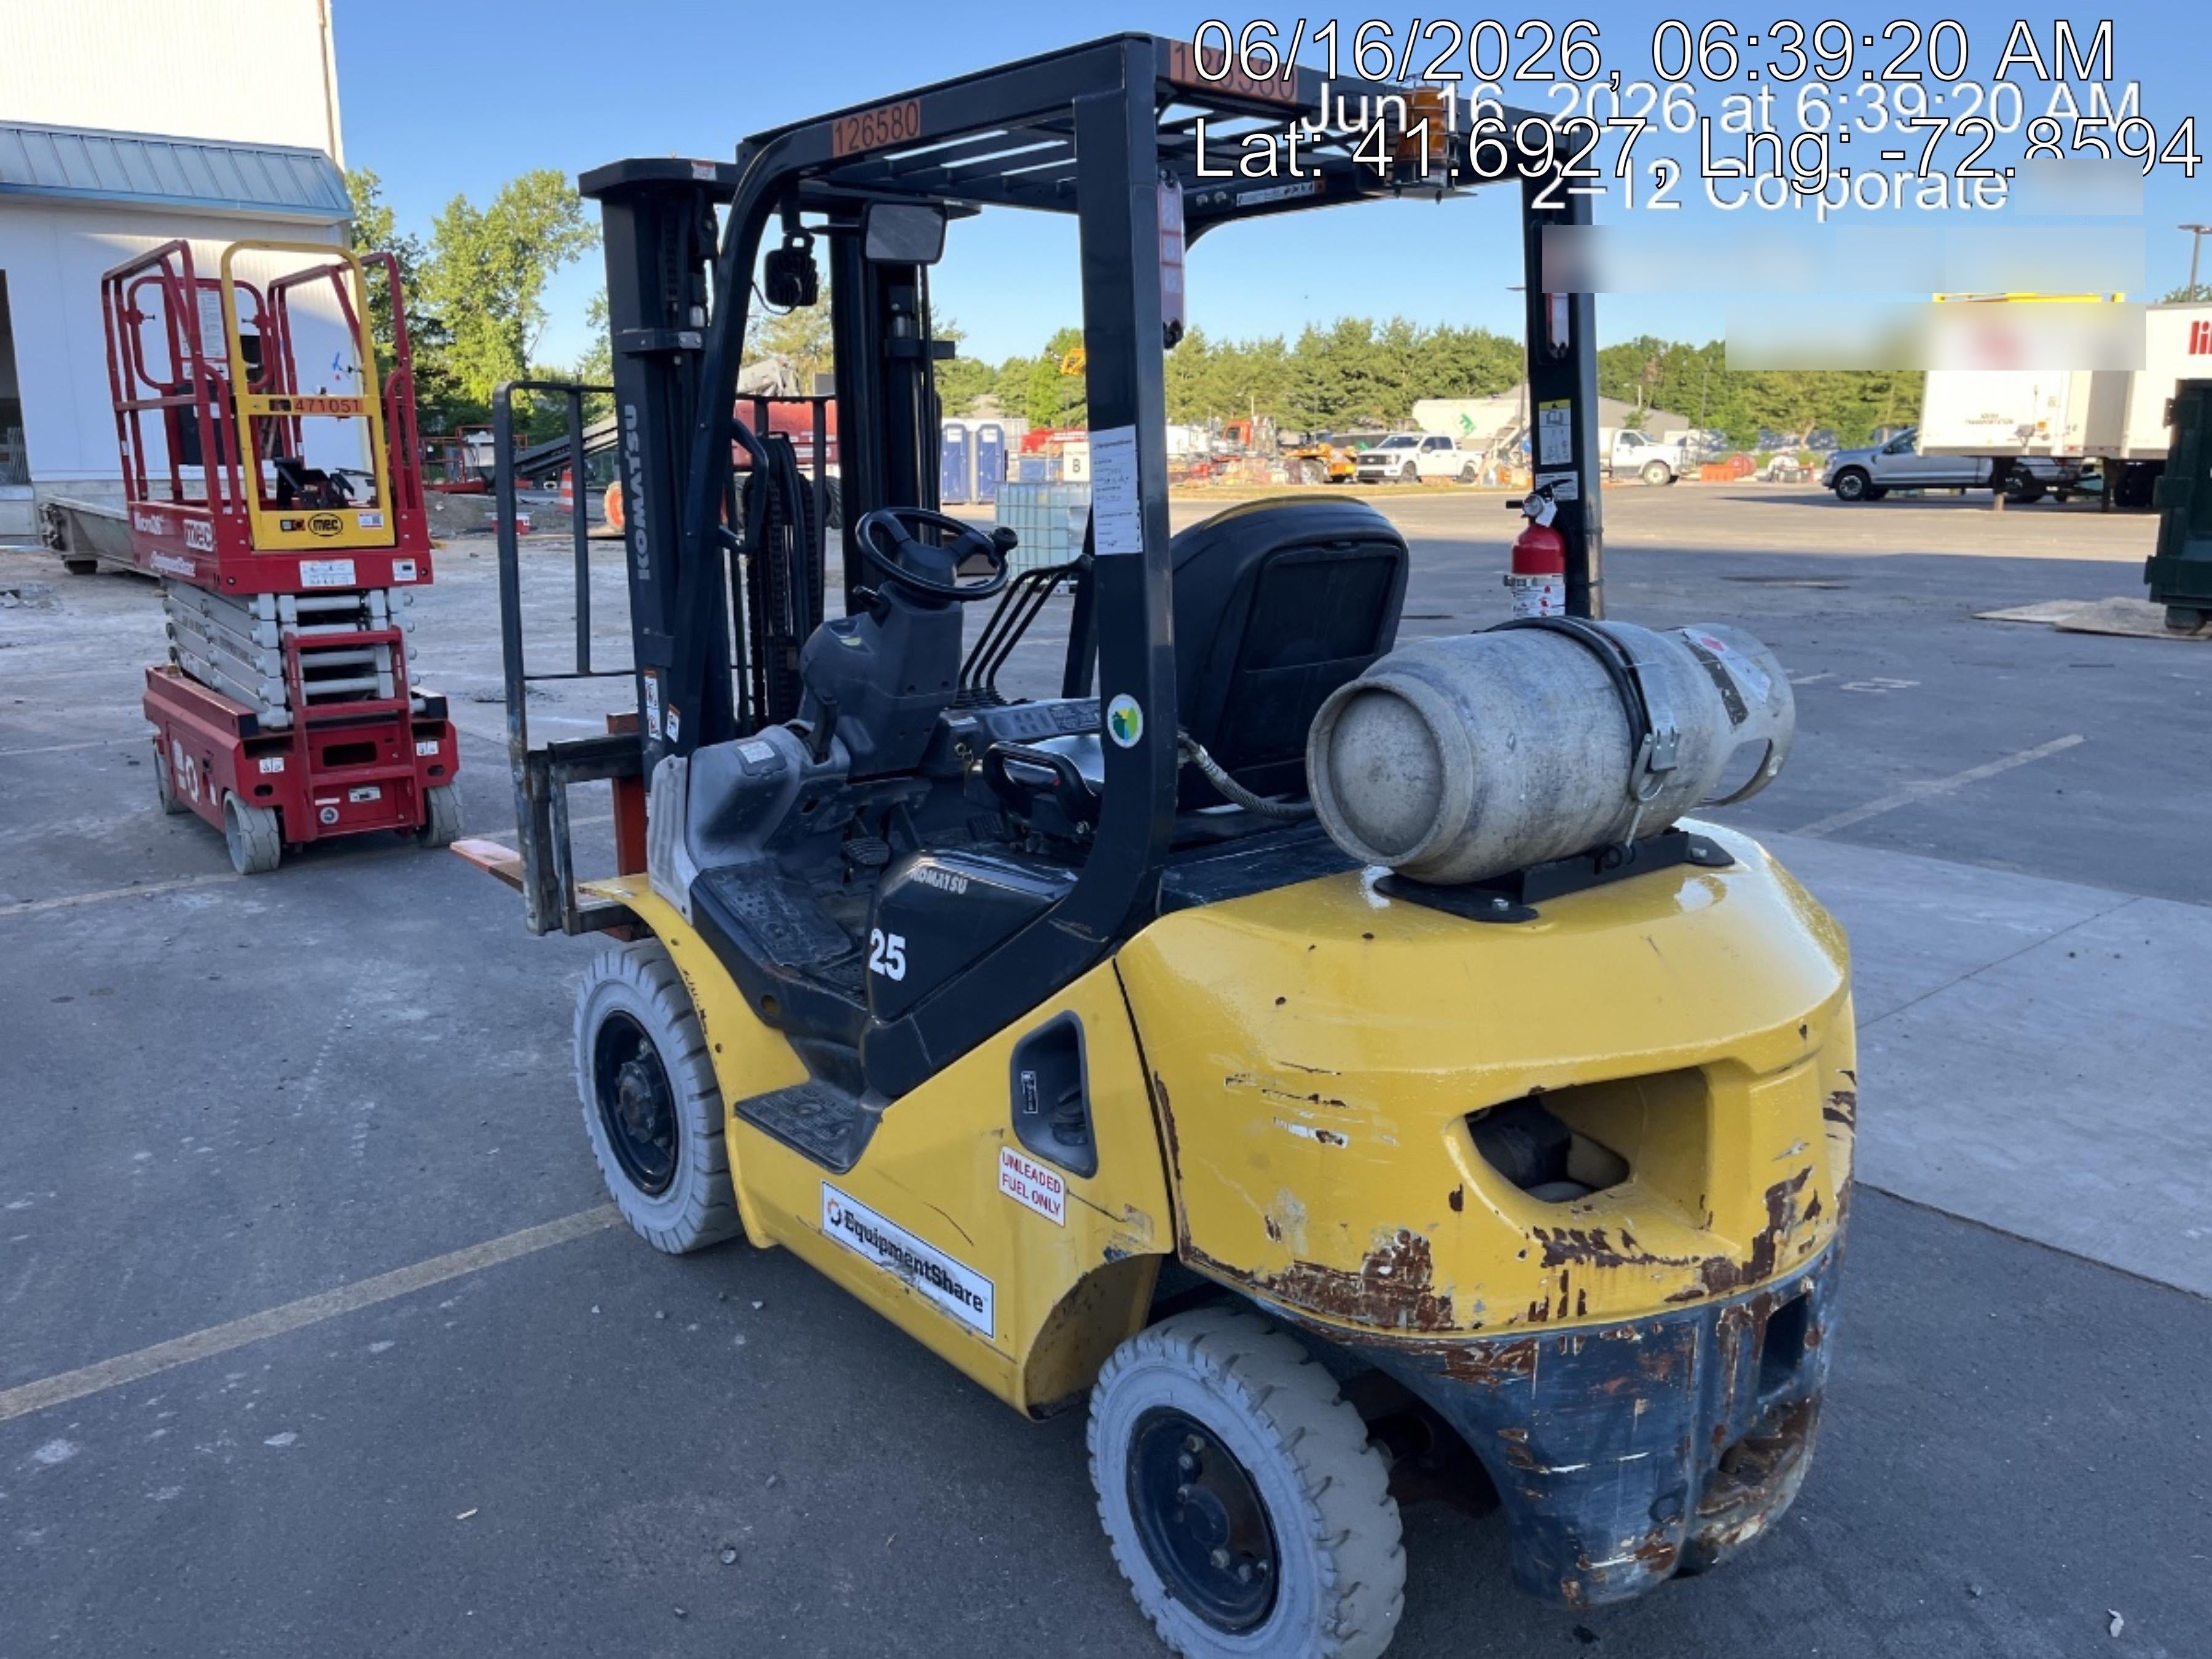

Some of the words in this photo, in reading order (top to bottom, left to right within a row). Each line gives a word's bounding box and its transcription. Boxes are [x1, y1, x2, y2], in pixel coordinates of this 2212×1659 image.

[834, 100, 919, 154] 126580
[294, 399, 361, 413] 471051
[1072, 458, 1081, 473] B
[624, 404, 650, 580] KOMATSU
[910, 866, 968, 895] KOMATSU
[869, 928, 906, 981] 25
[1002, 1151, 1062, 1195] UNLEADED
[1002, 1174, 1029, 1200] FUEL
[1032, 1190, 1061, 1217] ONLY
[843, 1210, 984, 1313] EquipmentShare
